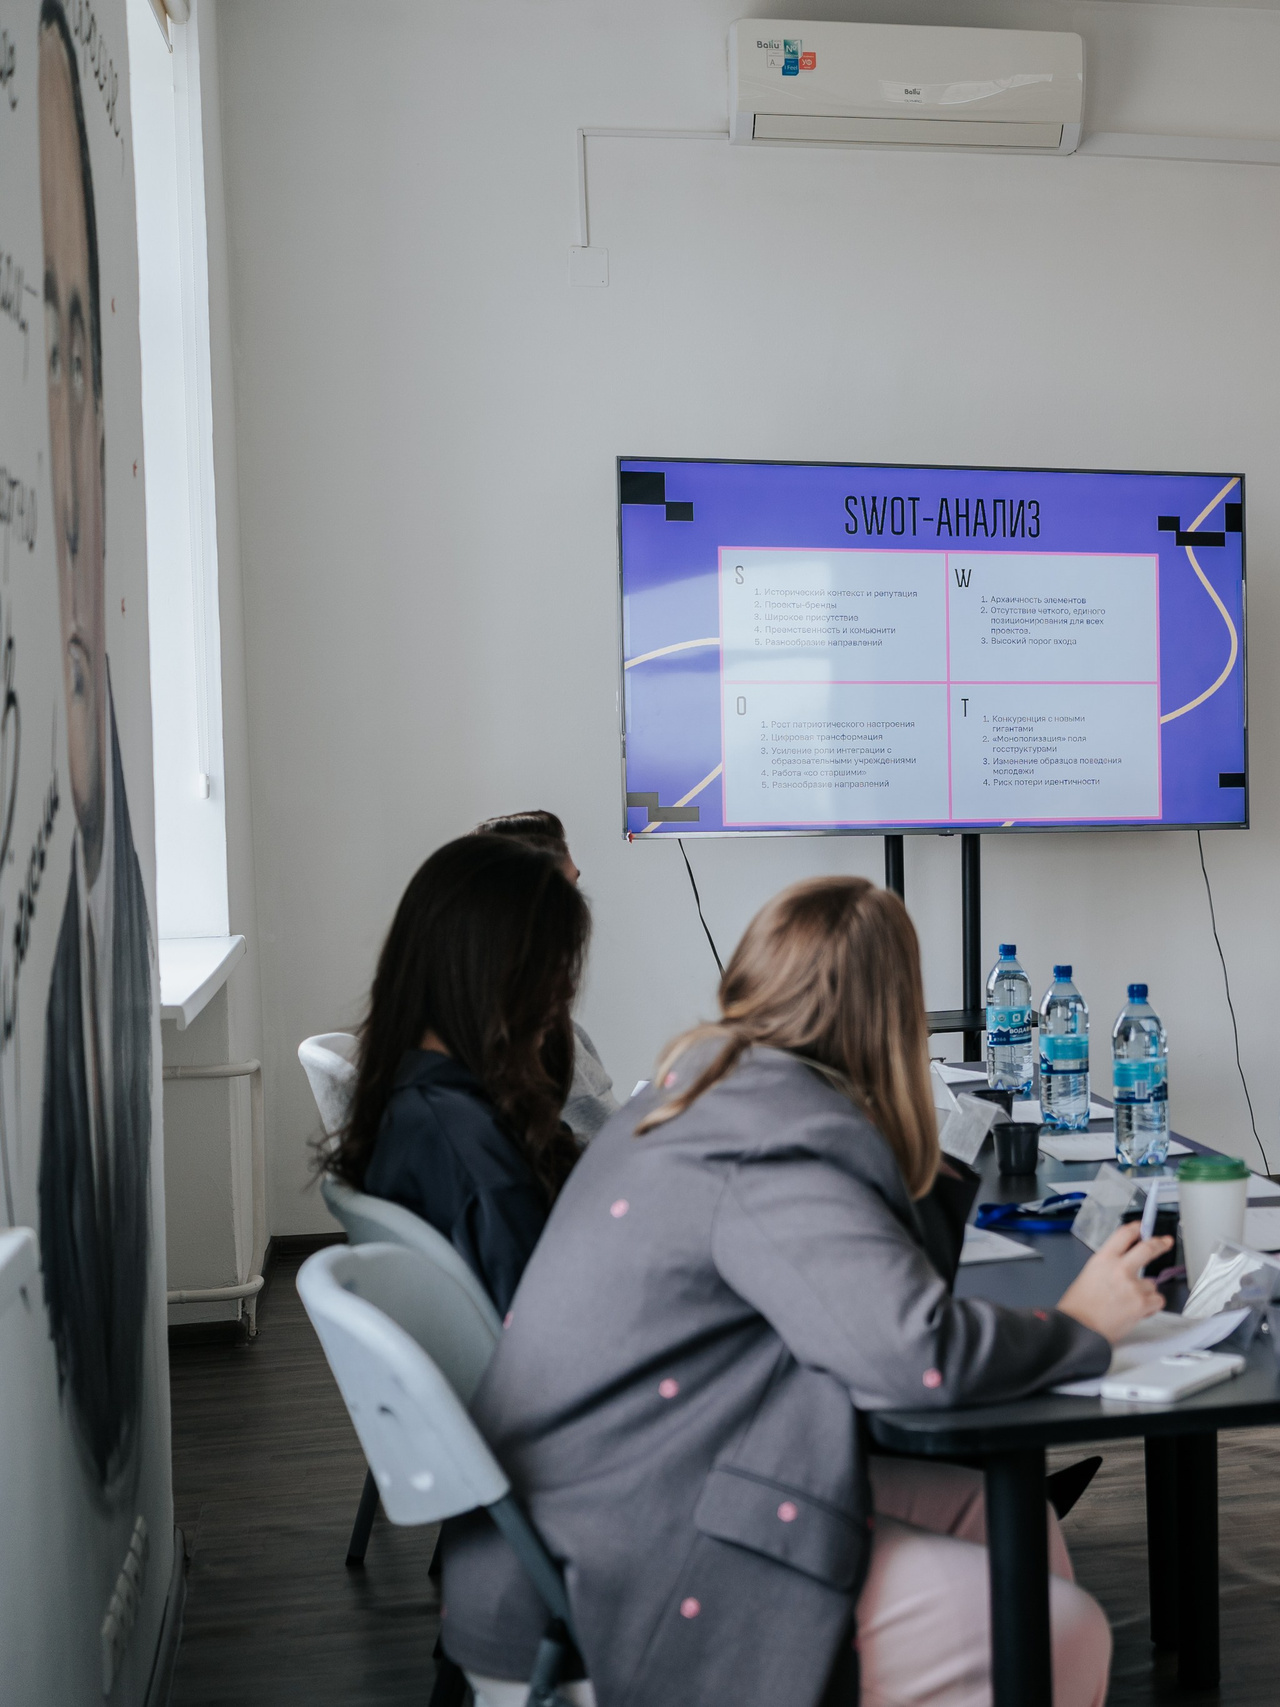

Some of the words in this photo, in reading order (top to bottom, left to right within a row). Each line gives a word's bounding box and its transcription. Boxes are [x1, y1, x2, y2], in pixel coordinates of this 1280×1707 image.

[844, 495, 1041, 538] SWOT-АНАЛИЗ
[764, 588, 825, 598] Исторический
[873, 591, 917, 599] репутация
[990, 596, 1042, 604] Архаичность
[765, 601, 837, 610] Проекты-бренды
[990, 606, 1036, 615] Отсутствие
[1073, 608, 1106, 616] единого
[764, 614, 804, 623] Широкое
[805, 615, 859, 623] присутствие
[991, 618, 1068, 626] позиционирования
[765, 626, 840, 634] Преемственность
[765, 638, 826, 647] Разнообразие
[827, 639, 883, 647] направлений
[991, 637, 1026, 645] Высокий
[1028, 638, 1051, 646] порог
[1053, 638, 1077, 646] входа
[992, 715, 1046, 724] Конкуренция
[771, 721, 791, 729] Рост
[793, 721, 864, 729] патриотического
[866, 721, 915, 729] настроения
[771, 733, 814, 743] Цифровая
[816, 733, 883, 742] трансформация
[992, 735, 1066, 744] «Монополизация»
[771, 747, 812, 755] Усиление
[814, 748, 834, 756] роли
[837, 747, 885, 755] интеграции
[992, 746, 1057, 754] госструктурами
[771, 757, 852, 765] образовательными
[854, 757, 916, 765] учреждениями
[1040, 757, 1078, 765] образцов
[1079, 757, 1122, 765] поведения
[772, 769, 801, 777] Работа
[772, 781, 832, 789] Разнообразие
[834, 780, 890, 789] направлений
[1014, 779, 1043, 787] потери
[1045, 778, 1100, 786] идентичности
